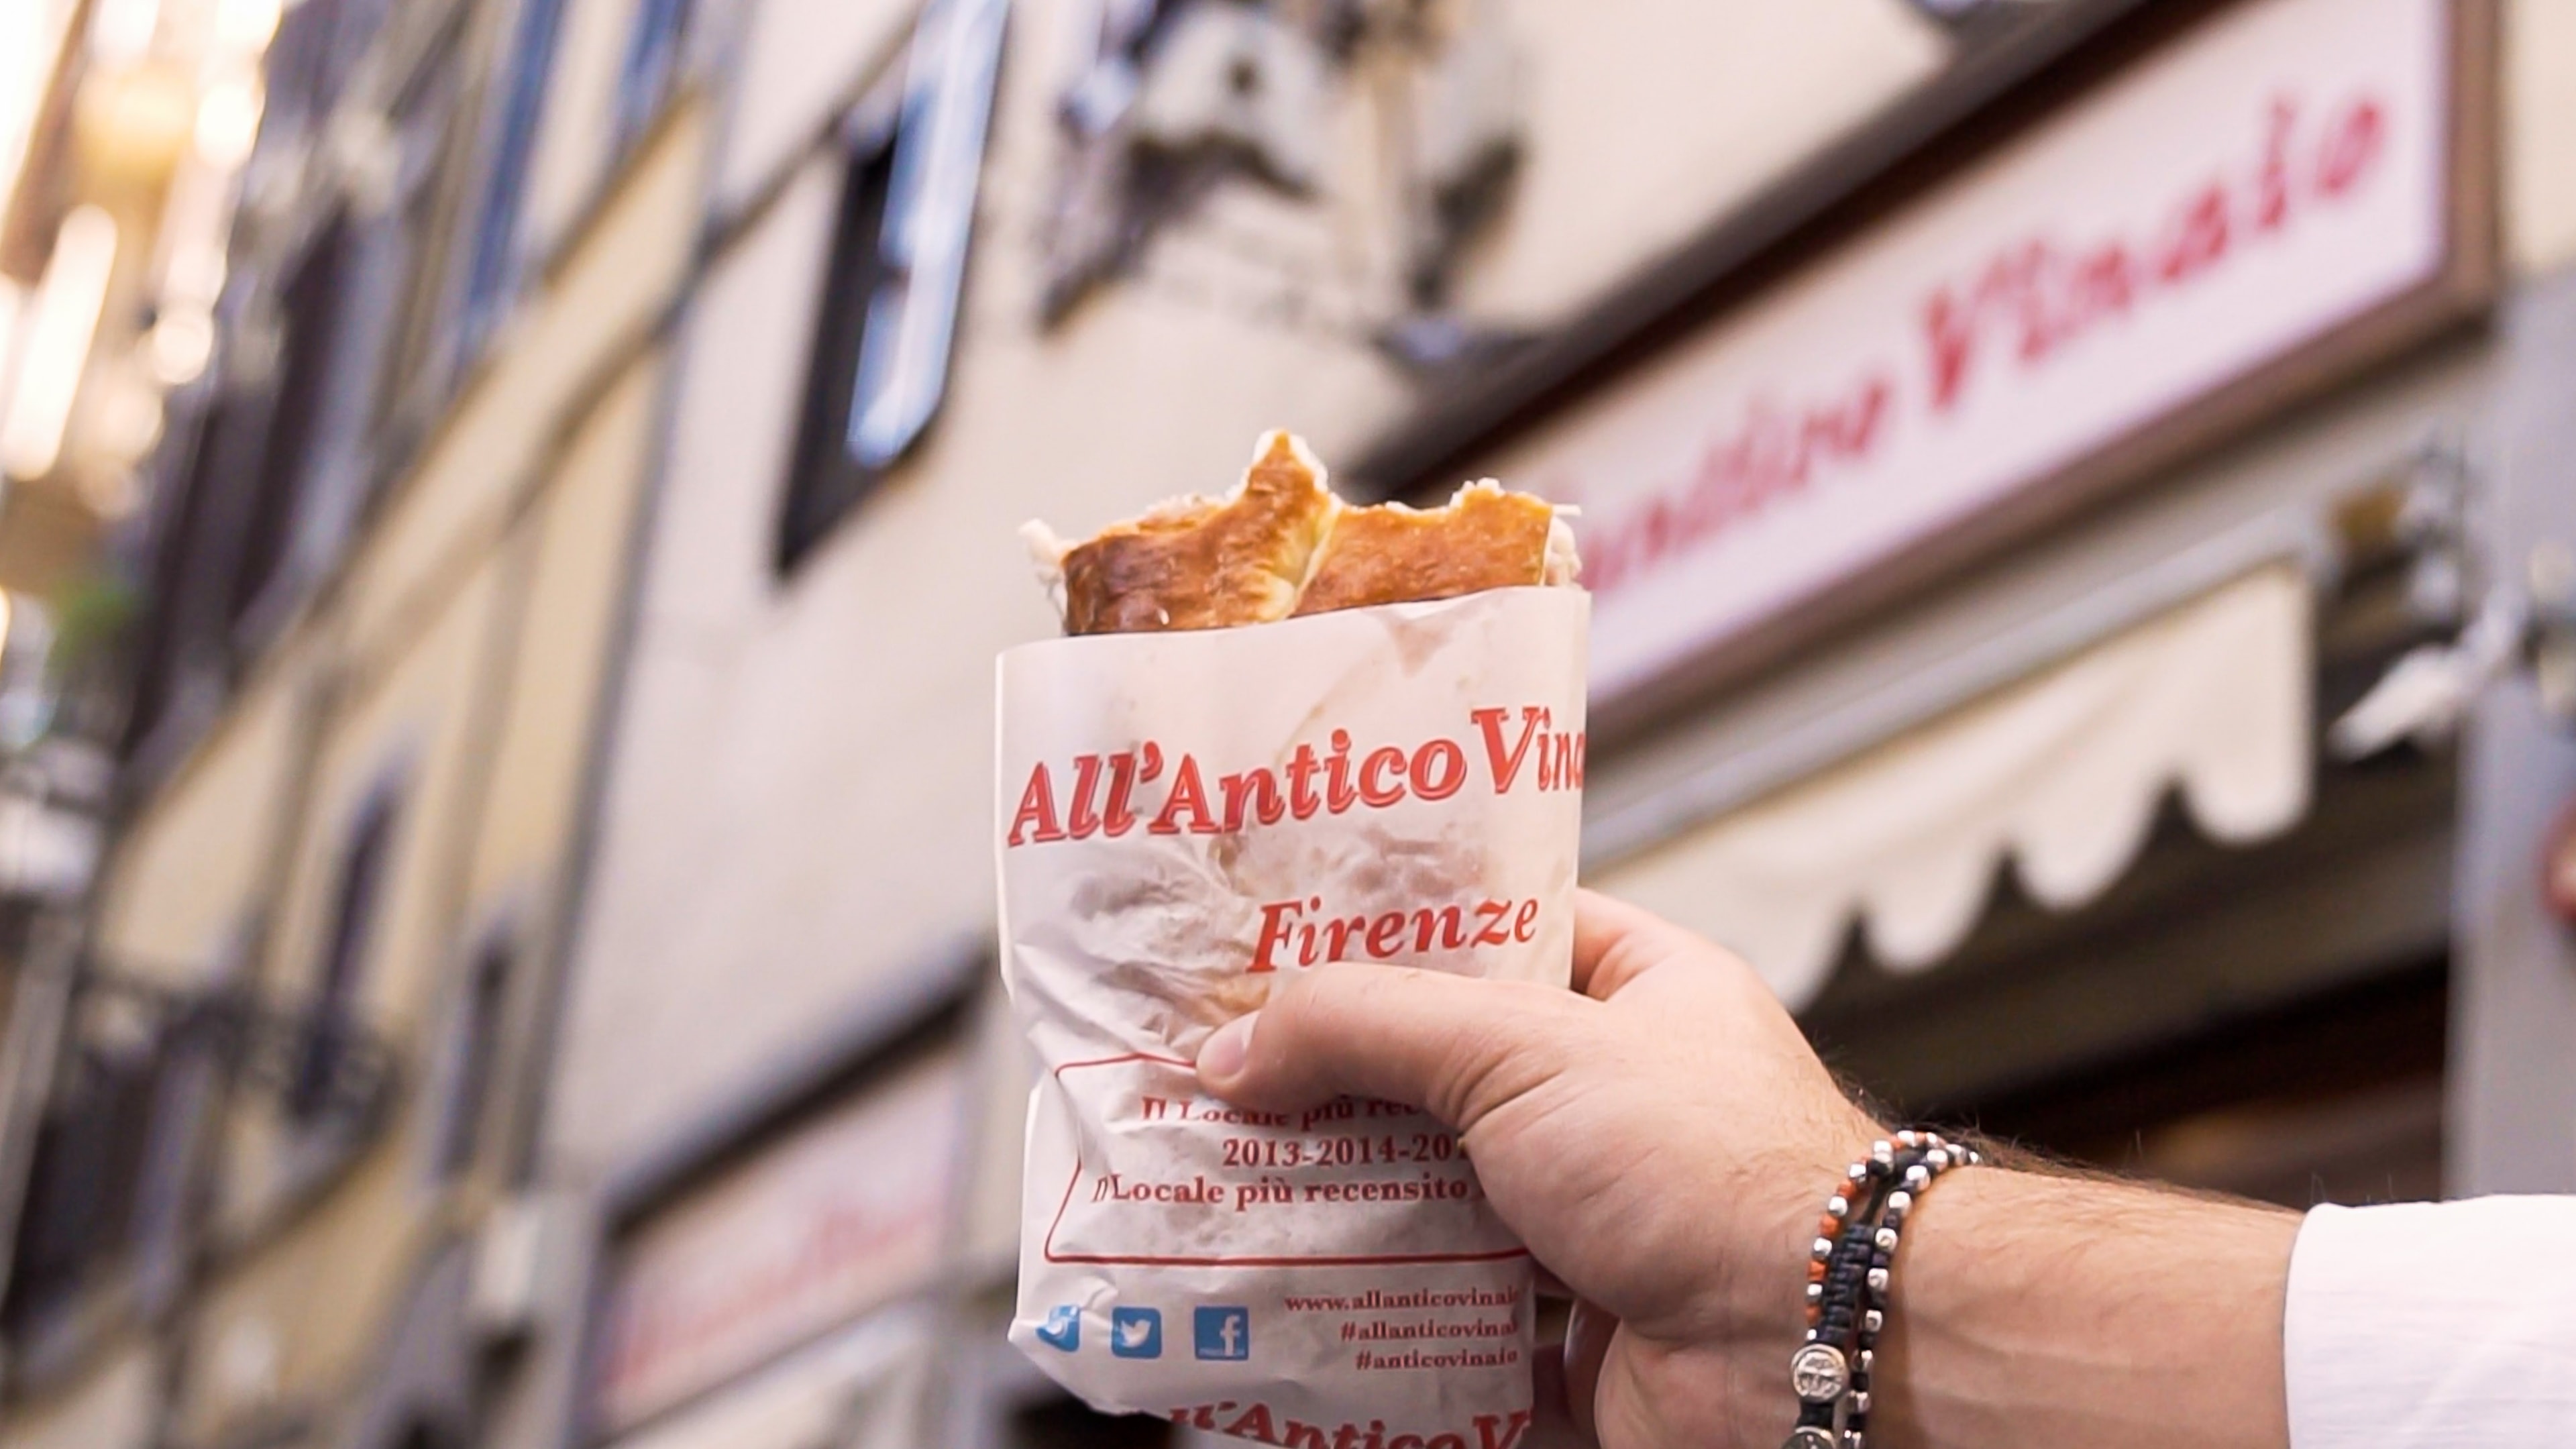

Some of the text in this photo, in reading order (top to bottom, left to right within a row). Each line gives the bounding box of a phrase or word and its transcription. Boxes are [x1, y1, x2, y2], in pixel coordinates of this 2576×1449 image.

[1924, 95, 2387, 413] Vinaio
[1008, 729, 1467, 847] All'Antico
[1245, 896, 1539, 973] Firenze
[1110, 1174, 1224, 1203] Locale
[1236, 1176, 1293, 1212] più
[1305, 1172, 1468, 1203] recensito
